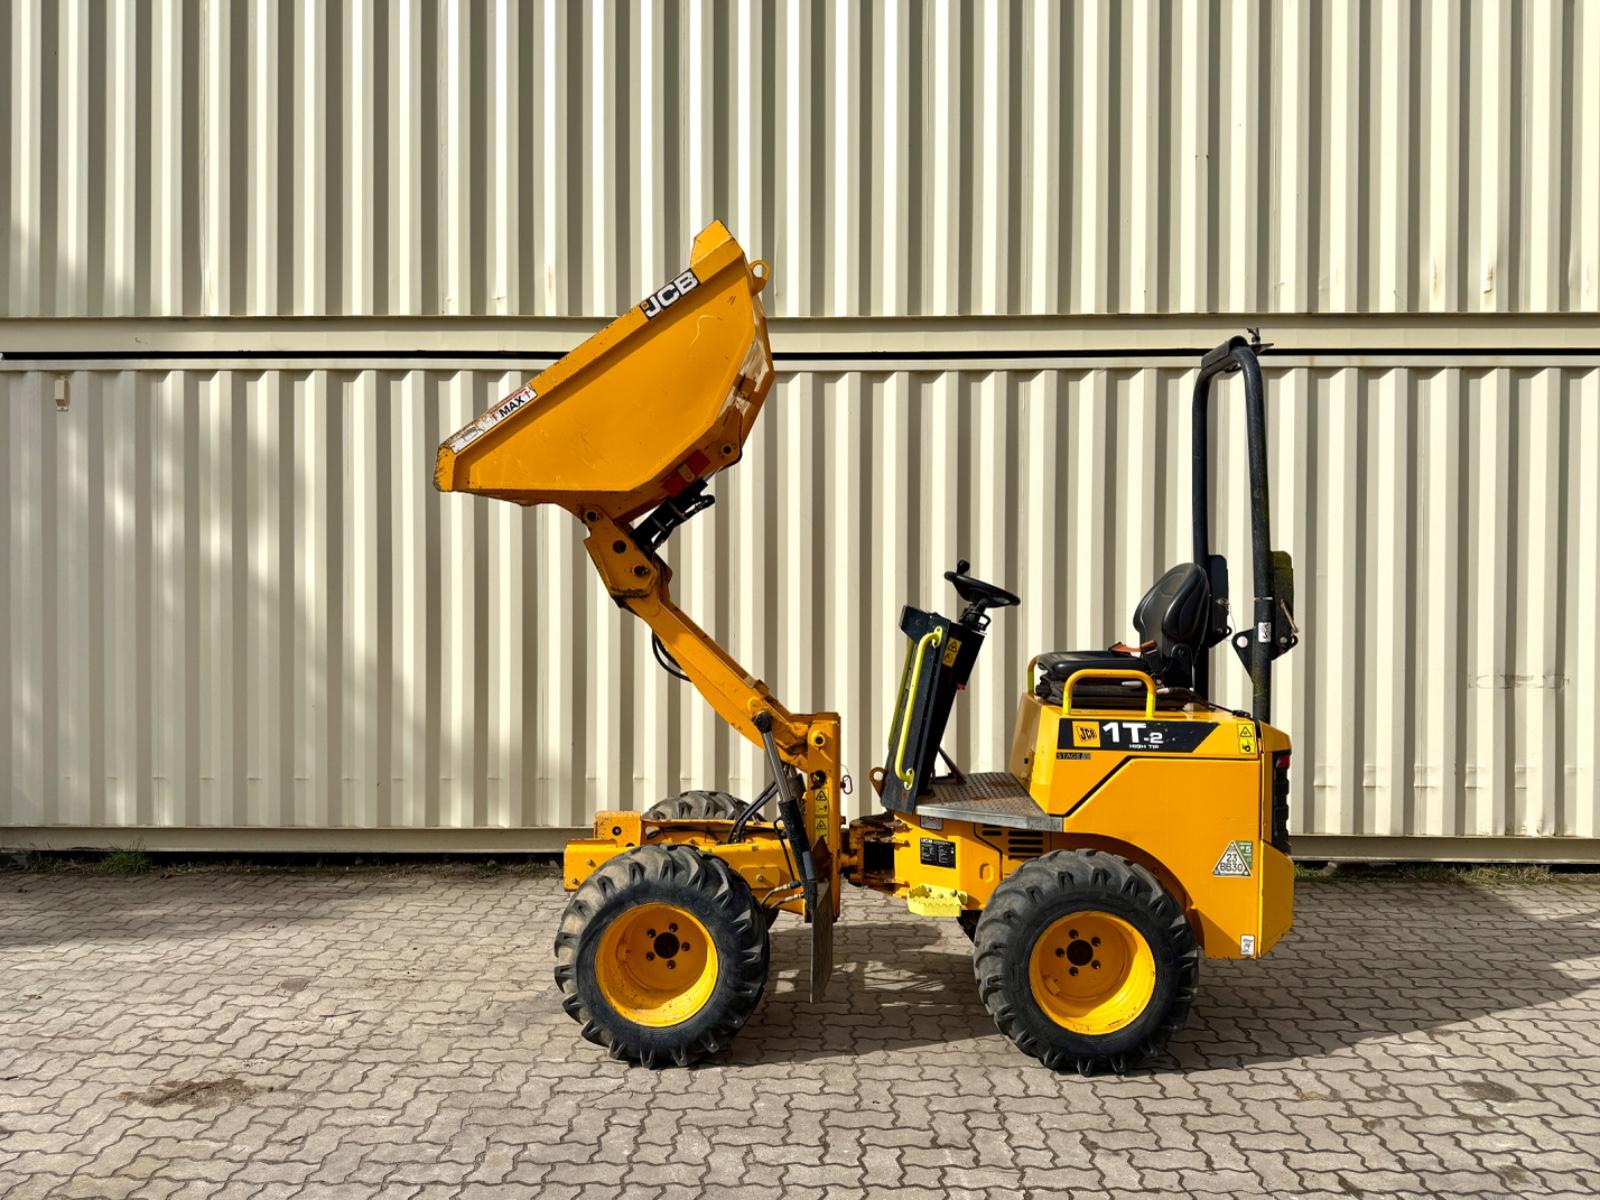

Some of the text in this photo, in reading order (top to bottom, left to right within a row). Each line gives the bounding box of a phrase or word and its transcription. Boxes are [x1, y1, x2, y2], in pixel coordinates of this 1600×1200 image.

[645, 271, 698, 318] JCB
[499, 395, 525, 418] MAX
[1226, 853, 1238, 863] 23
